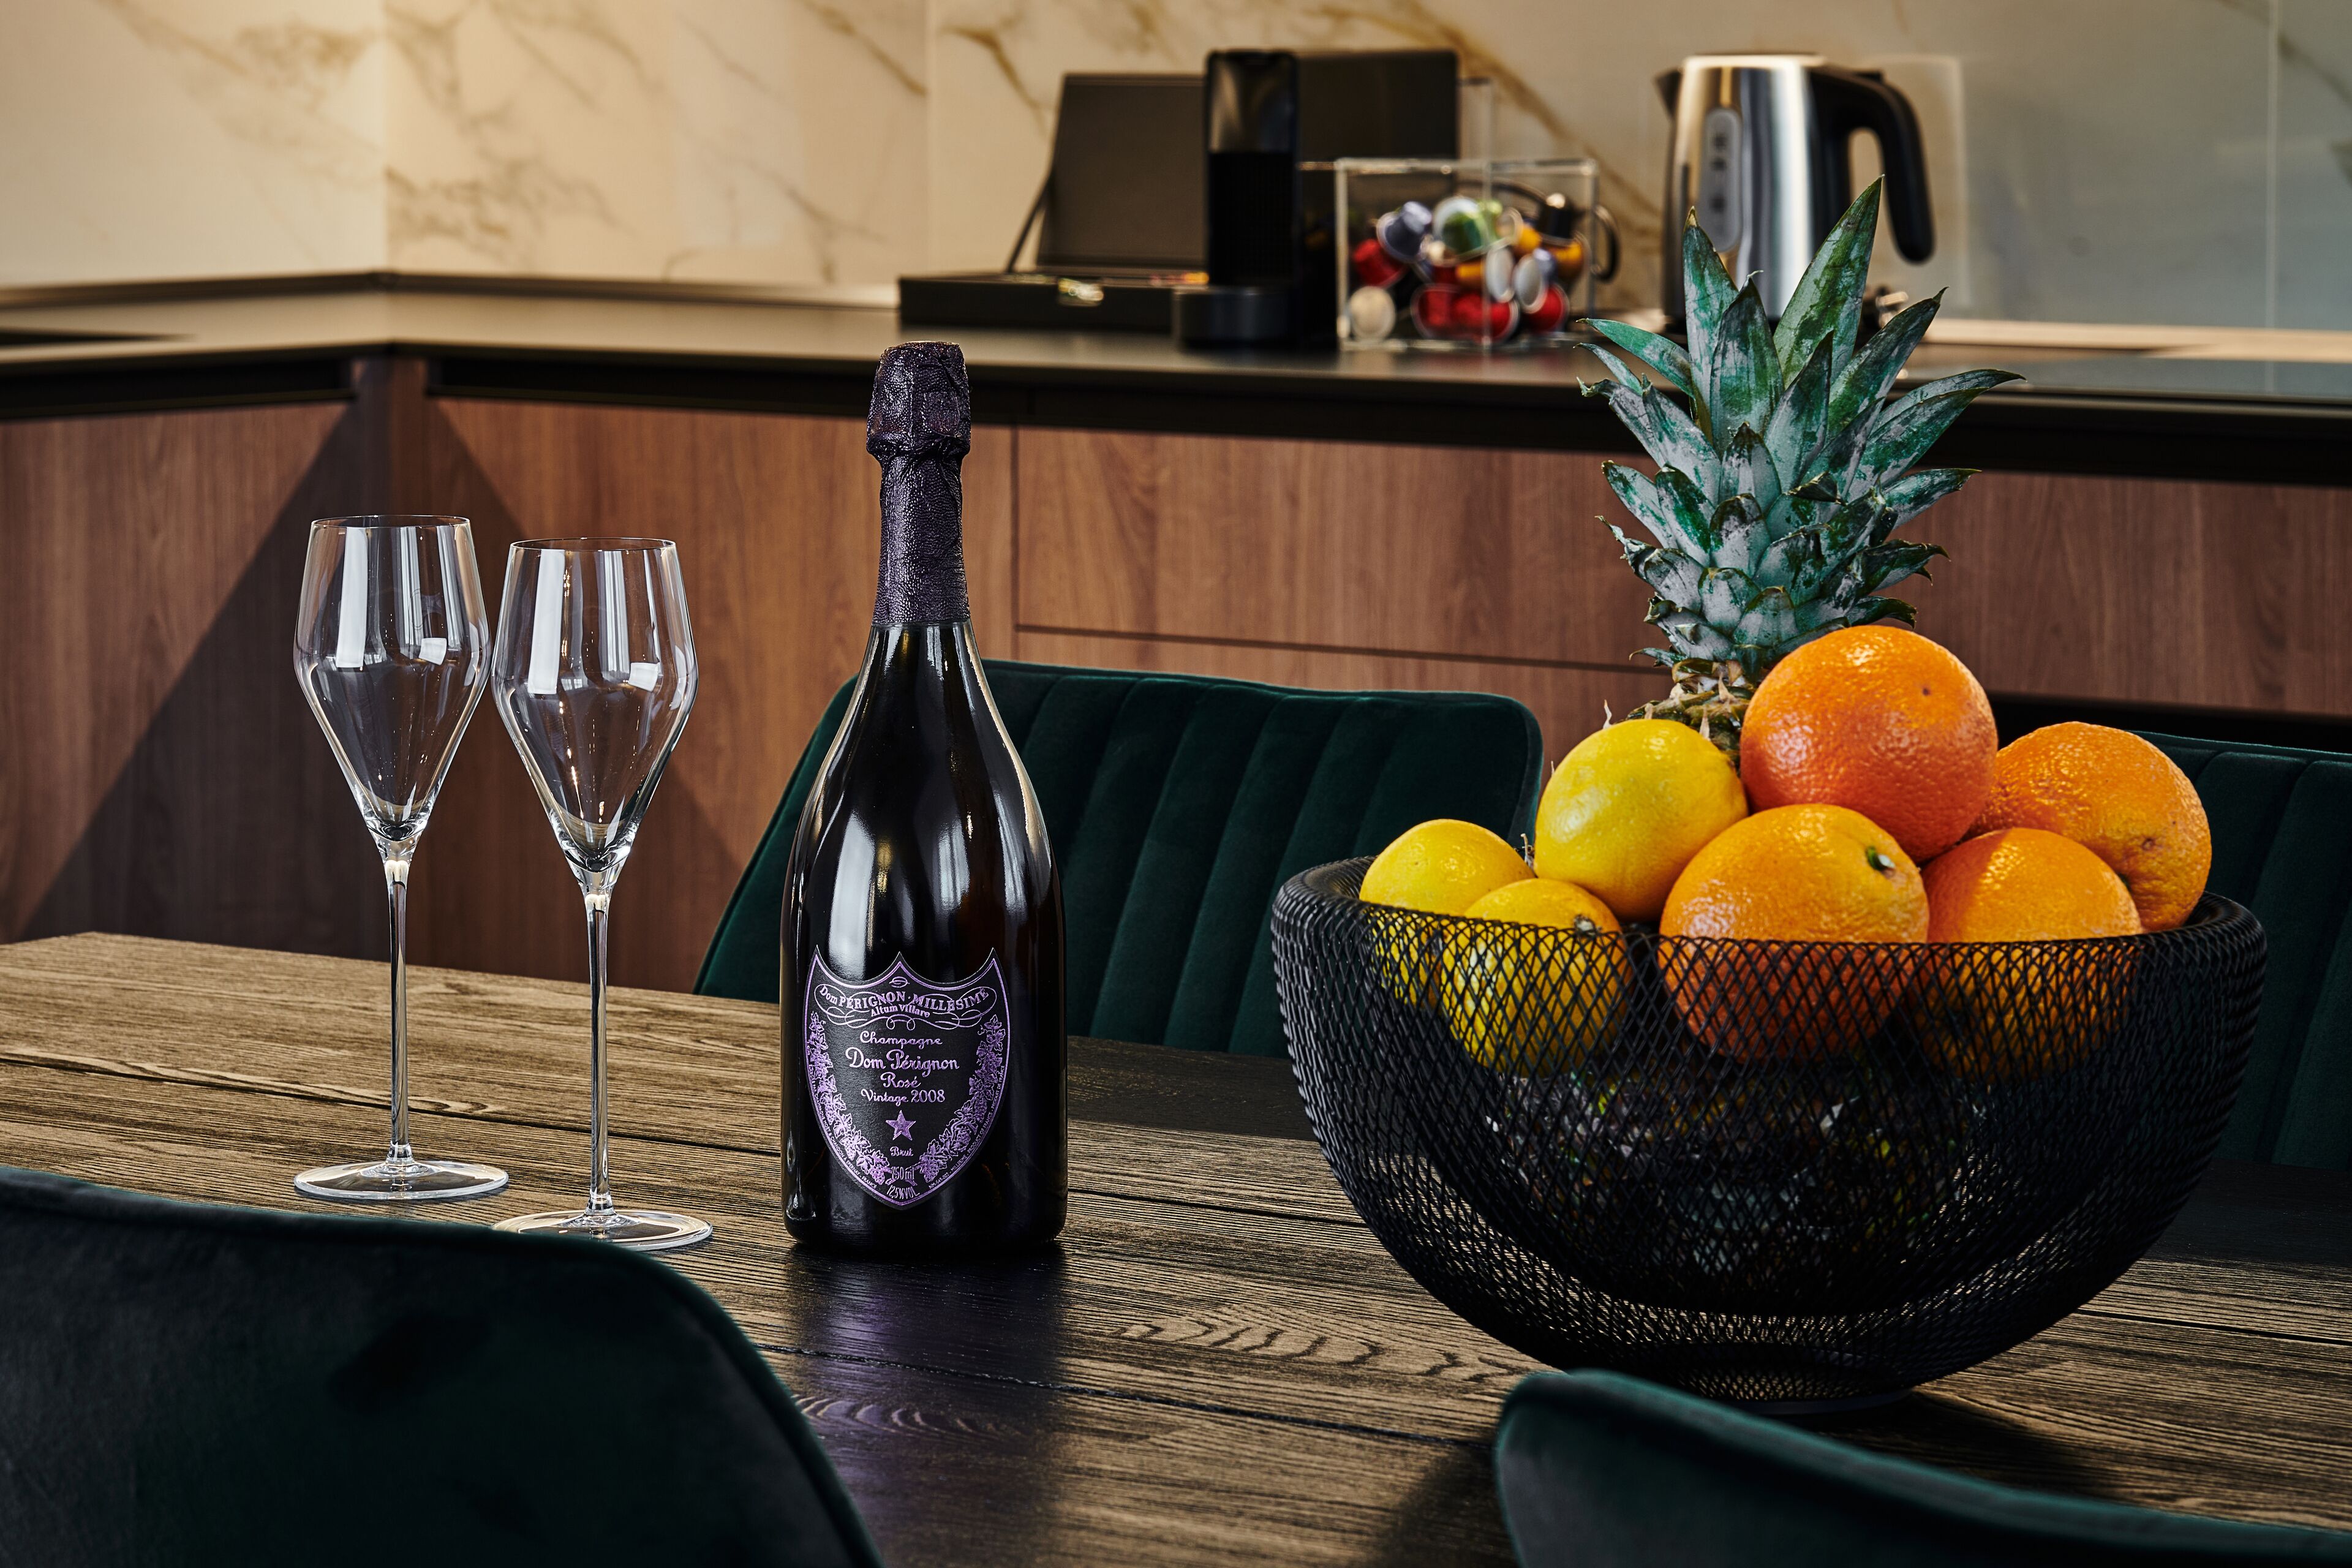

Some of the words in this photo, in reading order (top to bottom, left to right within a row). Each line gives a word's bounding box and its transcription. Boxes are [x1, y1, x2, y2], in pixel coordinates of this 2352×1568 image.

[819, 984, 838, 1005] Dom
[871, 1003, 899, 1017] Altum
[860, 1030, 943, 1049] Champagne
[845, 1047, 886, 1069] Dom
[886, 1049, 960, 1077] Pérignon
[880, 1071, 921, 1088] Rosé
[861, 1088, 909, 1107] Vintage
[911, 1089, 945, 1102] 2008
[889, 1146, 914, 1156] Brut
